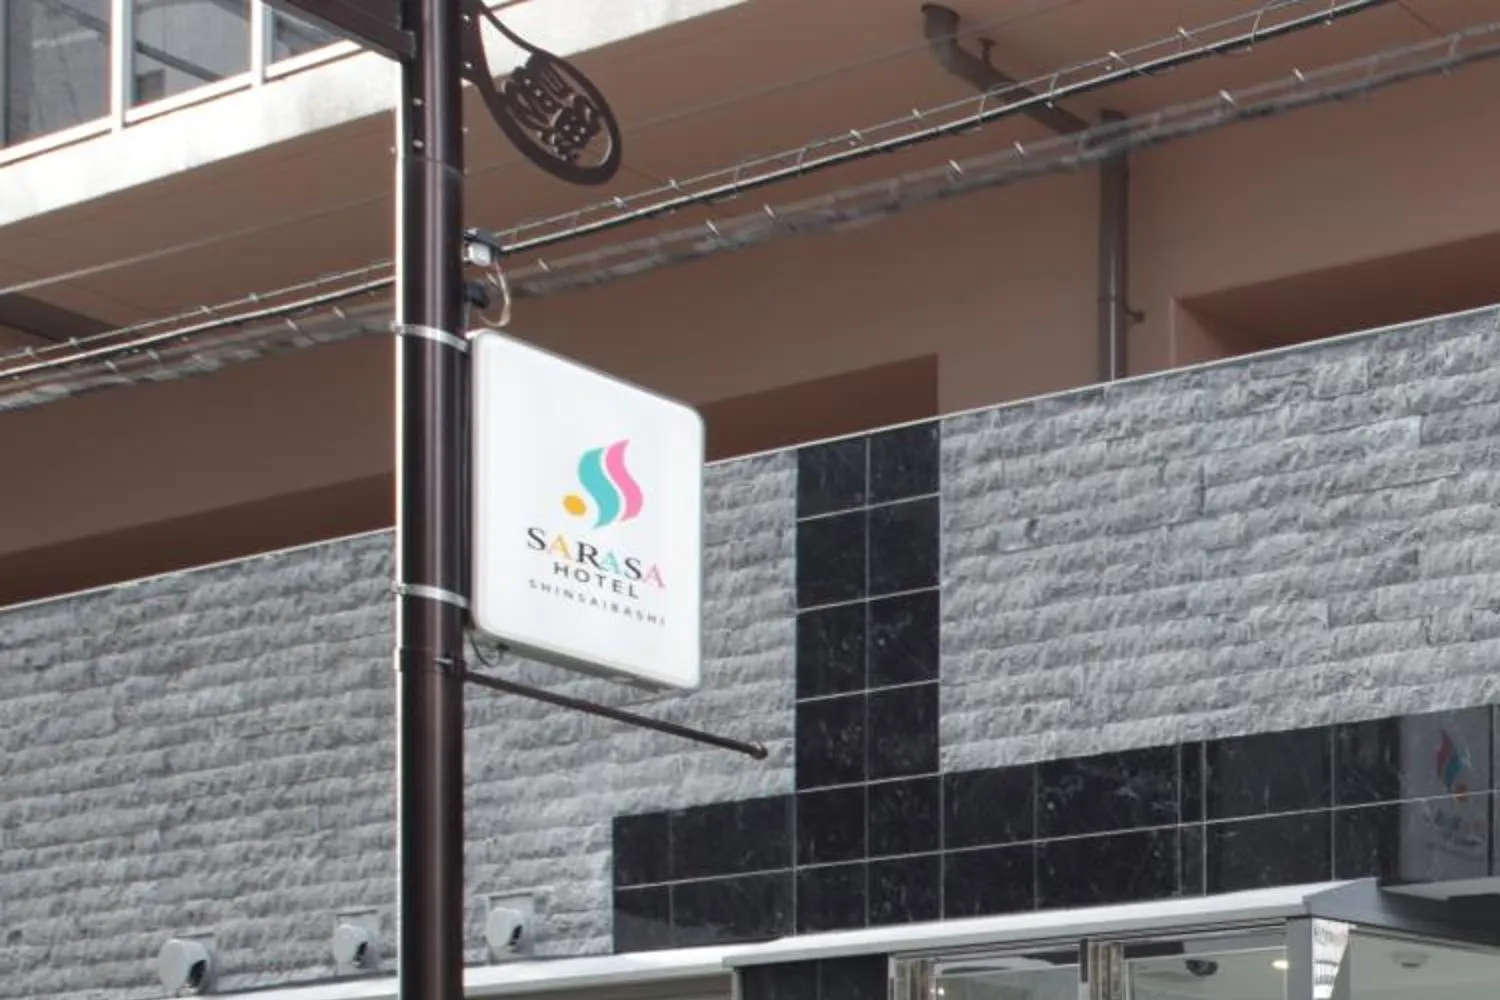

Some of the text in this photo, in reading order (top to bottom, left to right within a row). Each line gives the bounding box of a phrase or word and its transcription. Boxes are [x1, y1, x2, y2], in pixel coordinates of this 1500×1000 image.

[526, 526, 667, 589] SARASA
[552, 561, 640, 600] HOTEL
[528, 578, 666, 626] SHINSAIBASHI
